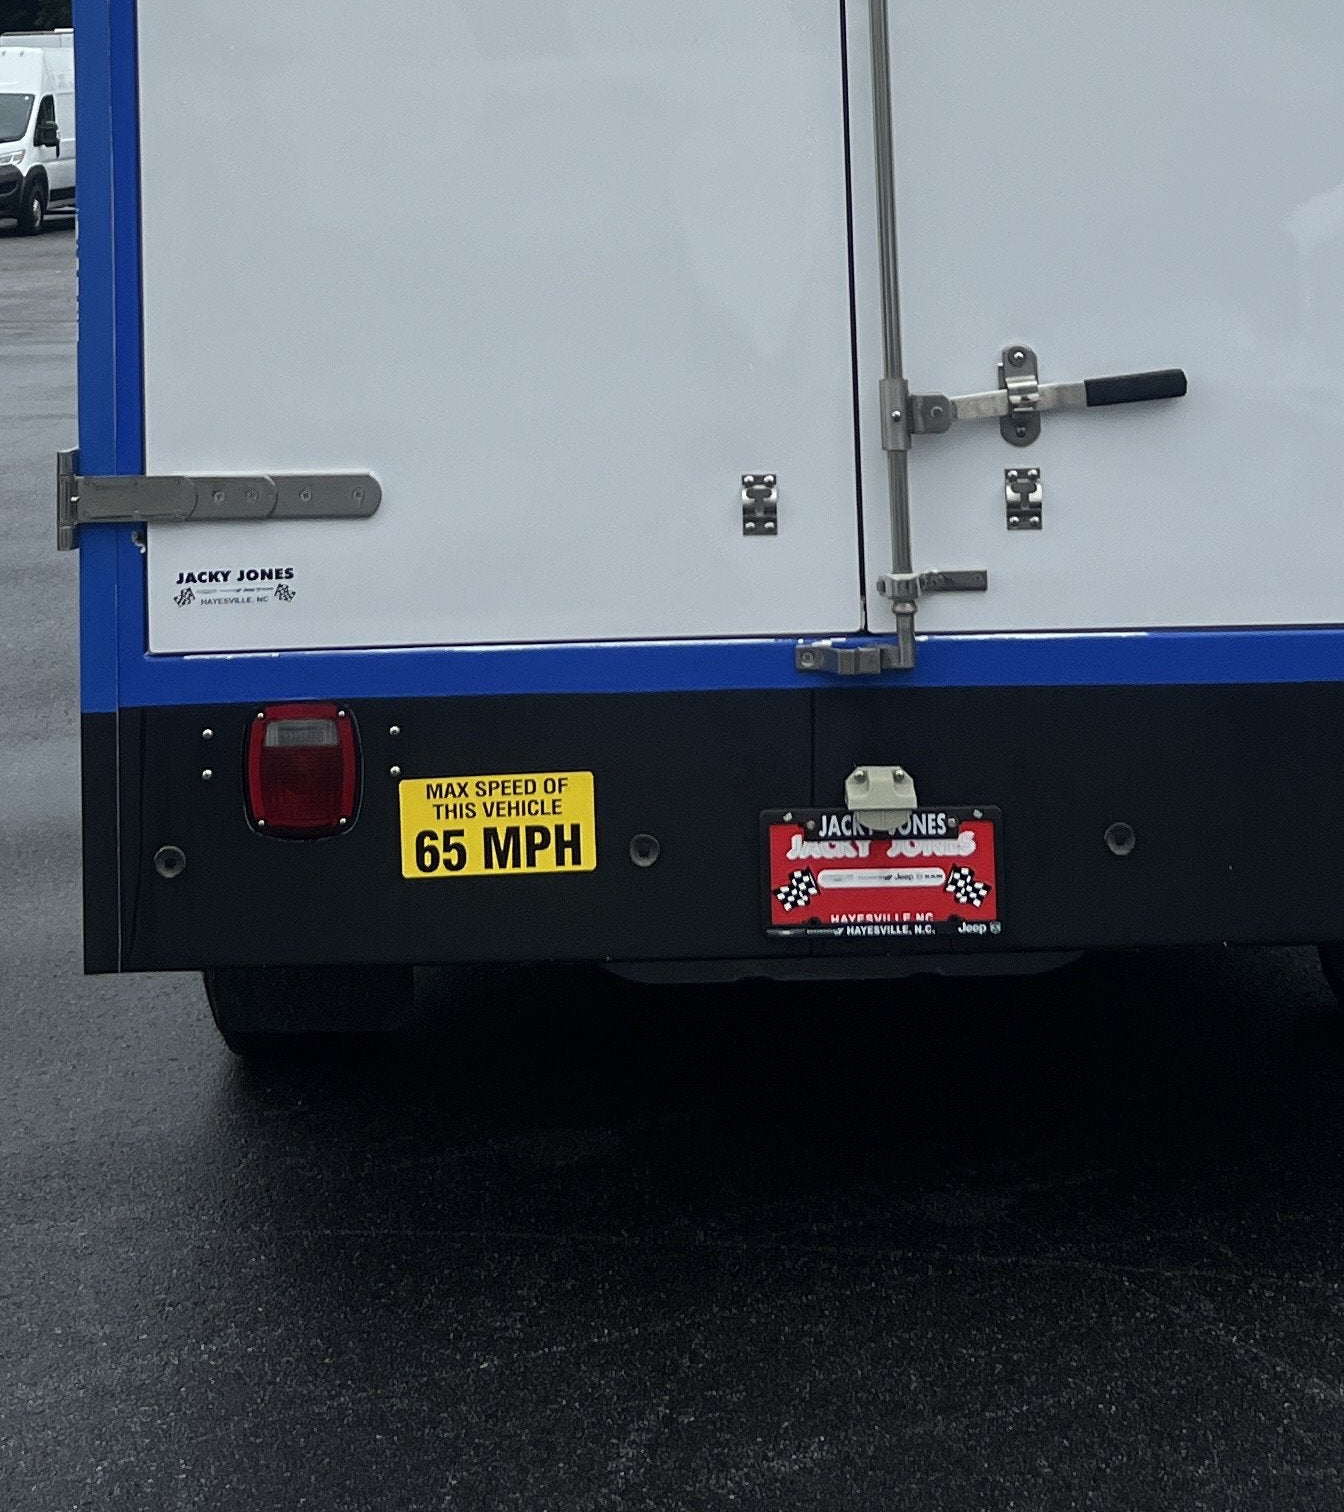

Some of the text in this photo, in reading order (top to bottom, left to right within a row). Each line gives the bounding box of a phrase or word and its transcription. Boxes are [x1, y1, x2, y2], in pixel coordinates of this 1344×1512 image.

[176, 568, 295, 584] JACKY JONES
[425, 777, 568, 800] MAX SPEED OF
[432, 798, 563, 820] THIS VEHICLE
[818, 814, 873, 837] JACK
[415, 823, 582, 873] 65 MPH
[957, 921, 987, 935] Jeep
